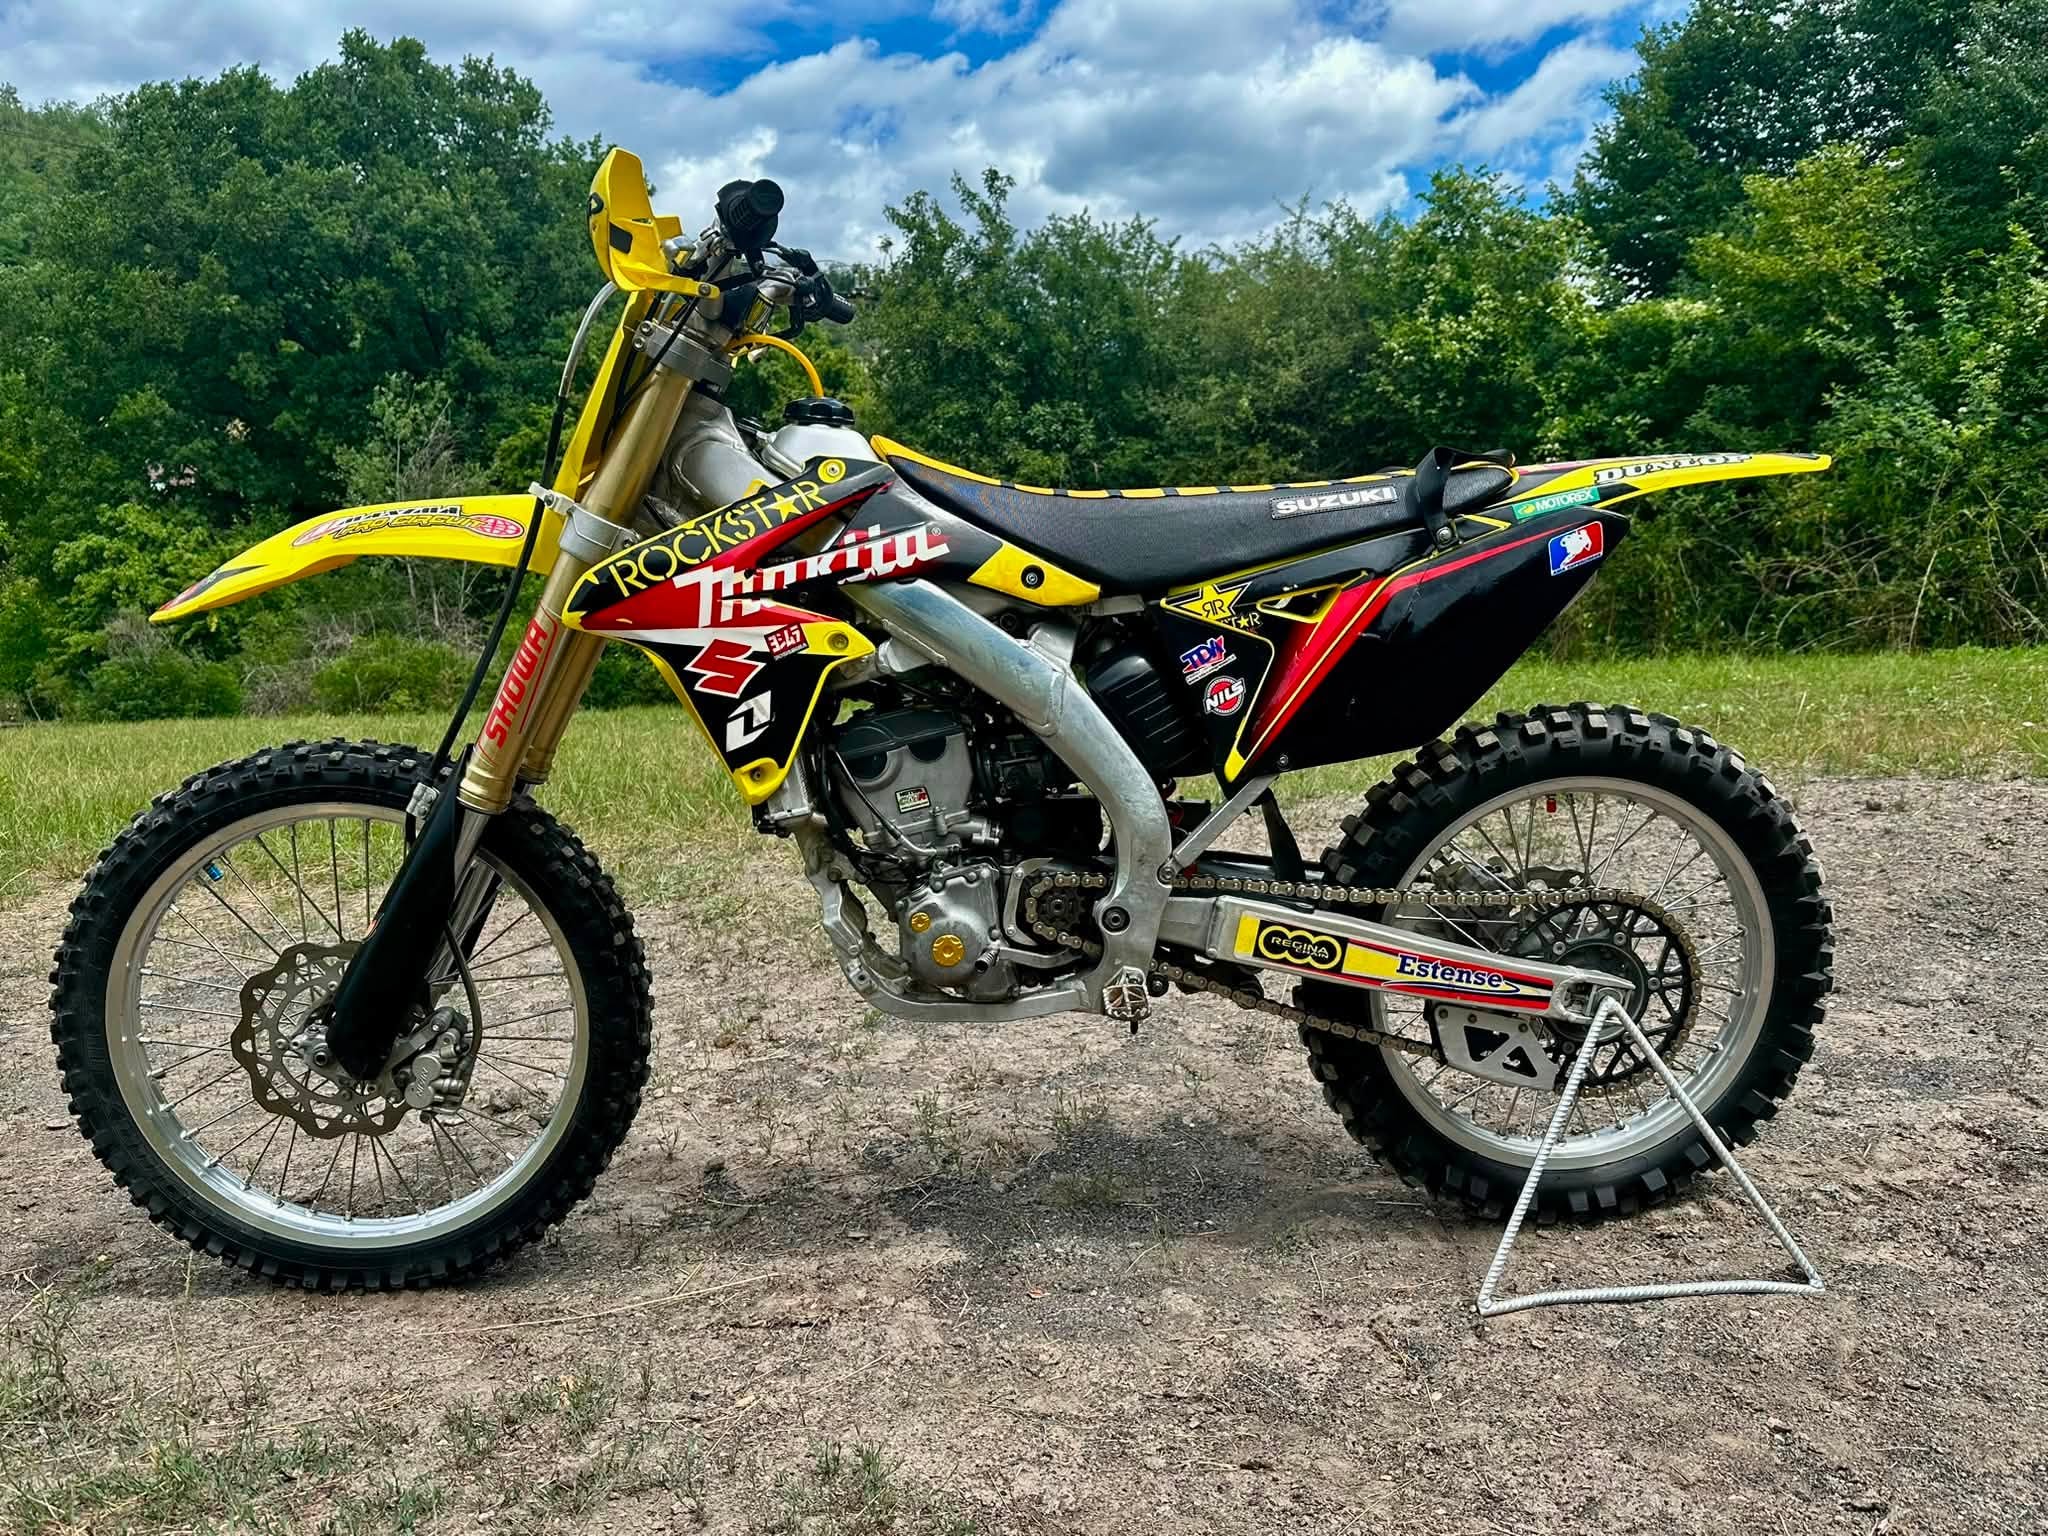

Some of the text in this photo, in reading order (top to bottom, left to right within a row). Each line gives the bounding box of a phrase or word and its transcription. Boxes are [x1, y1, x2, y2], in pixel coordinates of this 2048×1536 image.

[1594, 452, 1752, 484] DUNLOP
[1276, 485, 1395, 514] SUZUKI
[1535, 488, 1595, 511] MOTOREX
[333, 516, 389, 539] PRO
[485, 616, 548, 750] SHOWA
[1205, 680, 1245, 711] NILS
[1271, 936, 1329, 957] REGINA
[1395, 953, 1504, 989] Estense
